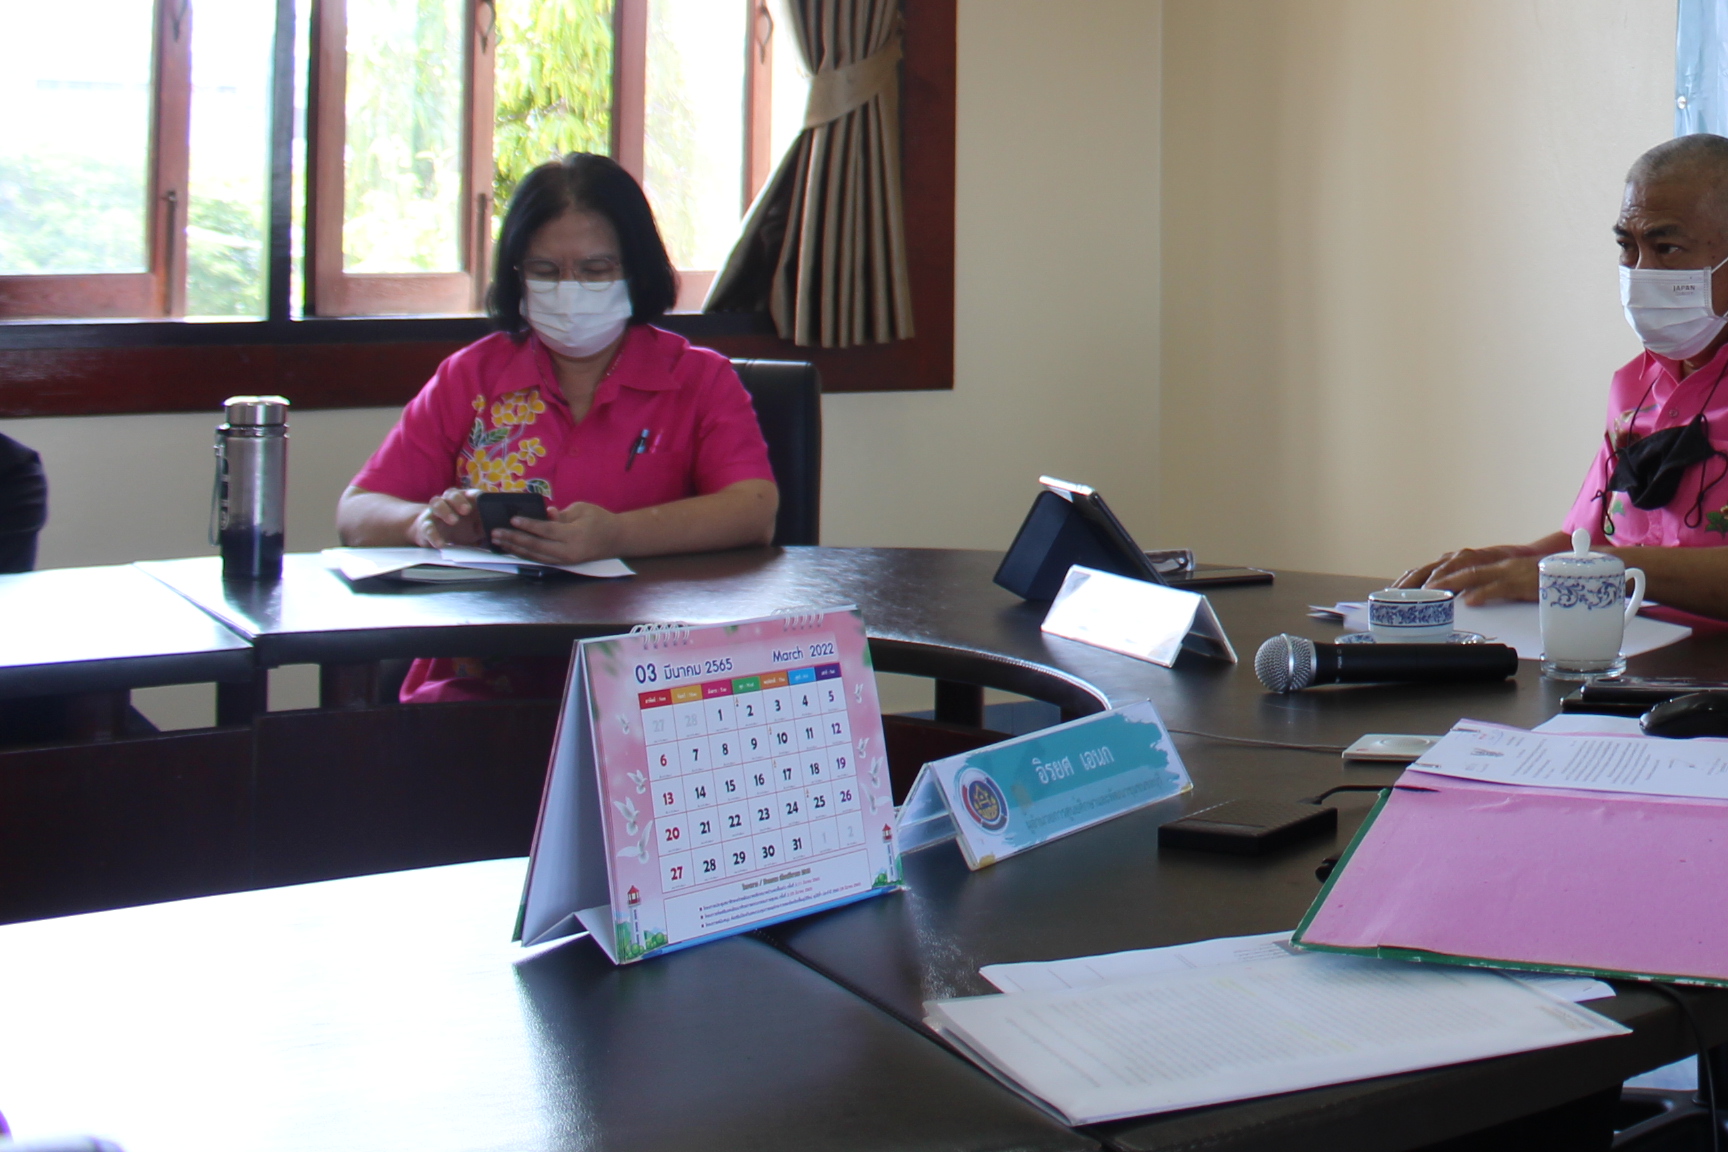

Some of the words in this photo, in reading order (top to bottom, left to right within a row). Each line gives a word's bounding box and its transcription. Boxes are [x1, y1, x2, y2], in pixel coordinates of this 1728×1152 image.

[635, 663, 657, 684] 03
[663, 662, 702, 680] มีนาคม
[704, 657, 733, 674] 2565
[772, 645, 803, 663] March
[809, 642, 834, 657] 2022
[717, 709, 723, 721] 1
[746, 705, 754, 717] 2
[775, 700, 781, 711] 3
[802, 695, 809, 707] 4
[828, 691, 834, 702] 5
[660, 754, 667, 766] 6
[693, 749, 699, 761] 7
[722, 743, 728, 755] 8
[751, 738, 757, 750] 9
[777, 732, 788, 744] 10
[806, 728, 814, 739] 11
[831, 723, 841, 735] 12
[1079, 746, 1115, 771] เอนก
[663, 792, 674, 805] 13
[695, 786, 706, 799] 14
[725, 780, 736, 792] 15
[754, 774, 765, 786] 16
[783, 768, 792, 780] 17
[810, 763, 820, 775] 18
[836, 757, 846, 769] 19
[665, 827, 680, 841] 20
[700, 821, 711, 834] 21
[728, 814, 742, 828] 22
[758, 808, 770, 821] 23
[786, 801, 798, 815] 24
[813, 796, 826, 808] 25
[840, 790, 852, 803] 26
[670, 866, 683, 881] 27
[703, 859, 716, 873] 28
[733, 851, 746, 866] 29
[762, 845, 775, 858] 30
[792, 837, 802, 851] 31
